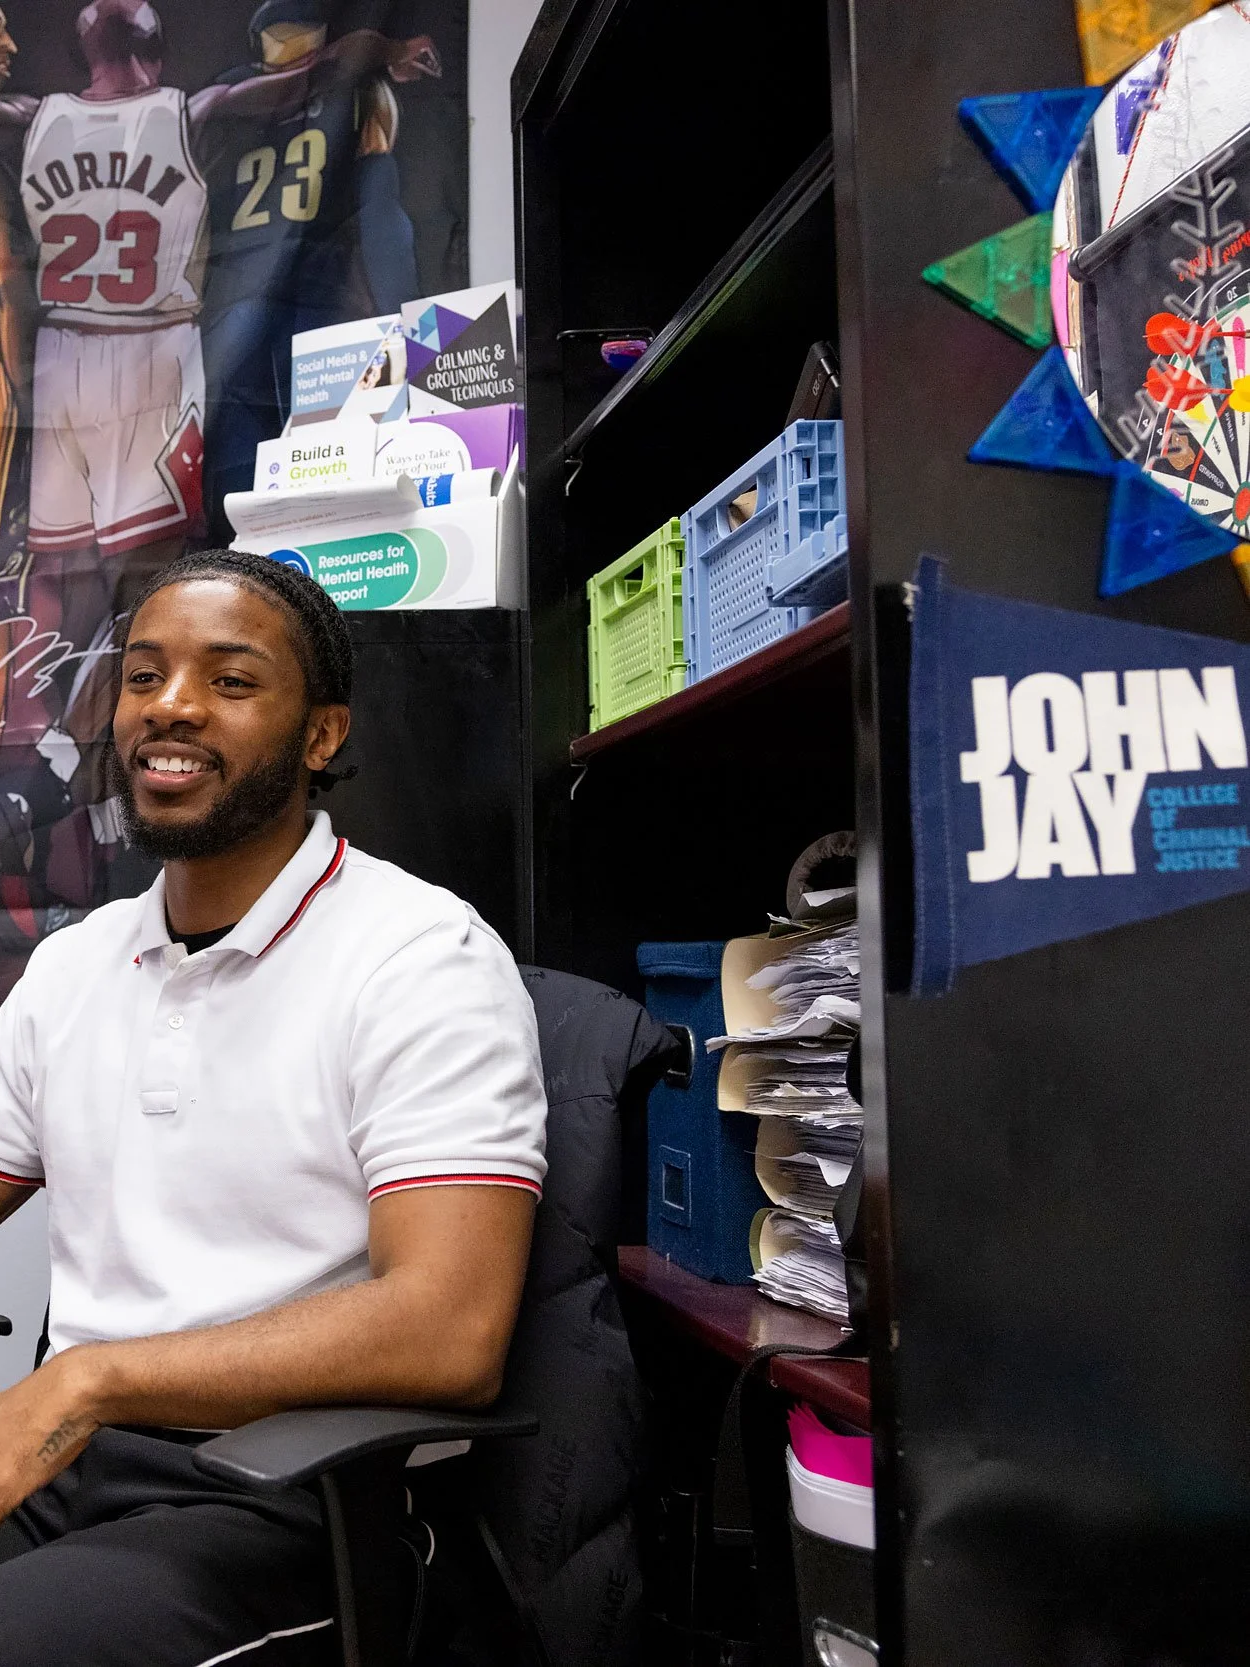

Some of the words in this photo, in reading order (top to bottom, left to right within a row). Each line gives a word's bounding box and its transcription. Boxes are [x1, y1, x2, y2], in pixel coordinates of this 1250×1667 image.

[25, 151, 187, 212] JORDAN
[232, 128, 327, 232] 23
[40, 211, 161, 304] 23
[296, 357, 326, 376] Social
[326, 351, 356, 370] Media
[434, 347, 491, 373] CALMING
[494, 343, 507, 361] &
[296, 375, 320, 391] Your
[321, 368, 354, 386] Mental
[426, 363, 499, 392] GROUNDING
[296, 389, 329, 407] Health
[450, 378, 515, 403] TECHNIQUES
[291, 445, 332, 463] Build
[335, 444, 345, 457] a
[386, 452, 414, 467] Ways
[415, 454, 426, 464] to
[427, 448, 452, 463] Take
[289, 459, 348, 481] Growth
[318, 548, 384, 570] Resources
[386, 545, 406, 560] for
[318, 568, 363, 587] Mental
[365, 562, 410, 581] Health
[959, 665, 1249, 784] JOHN
[1148, 783, 1239, 808] COLLEGE
[966, 772, 1148, 883] JAY
[1151, 808, 1178, 827] OF
[1152, 827, 1250, 850] CRIMINAL
[1155, 849, 1240, 873] JUSTICE
